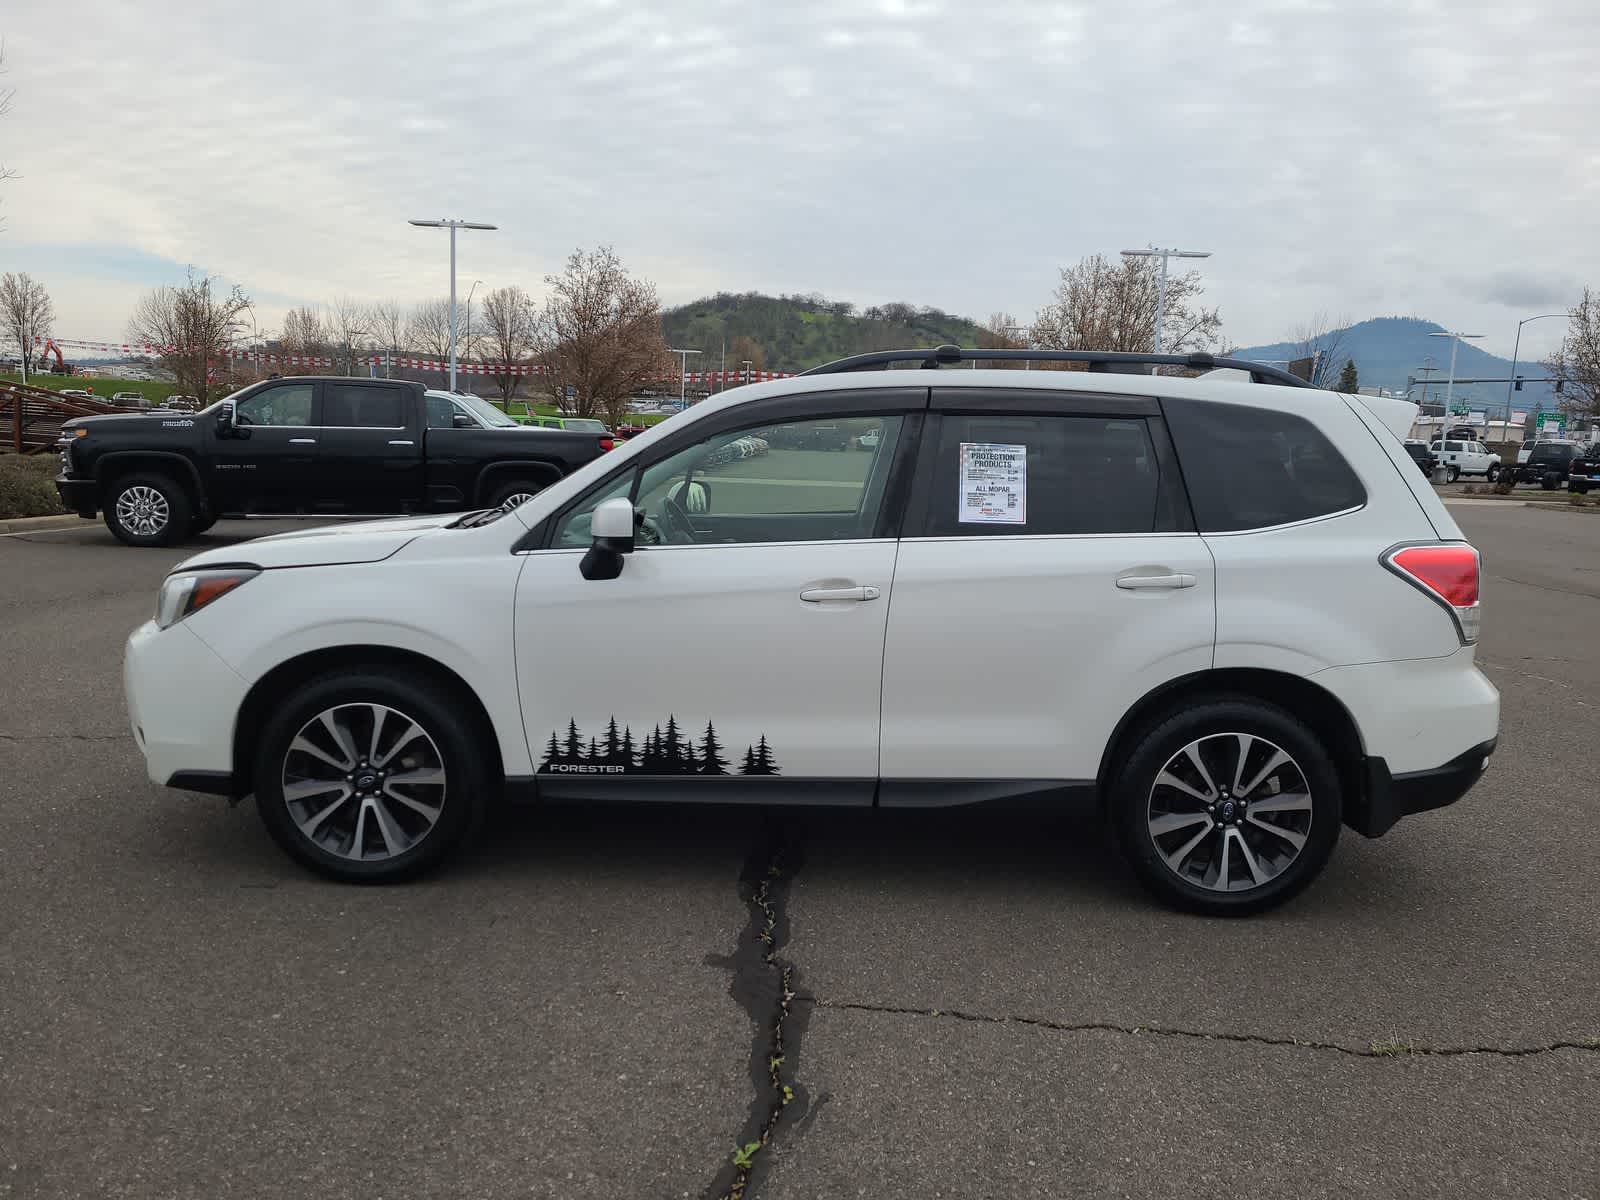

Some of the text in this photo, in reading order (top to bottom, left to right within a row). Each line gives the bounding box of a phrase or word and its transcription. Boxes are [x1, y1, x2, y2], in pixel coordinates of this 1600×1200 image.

[971, 453, 1016, 461] PROTECTION
[974, 460, 1012, 468] PRODUCTS
[549, 764, 625, 773] FORESTER
